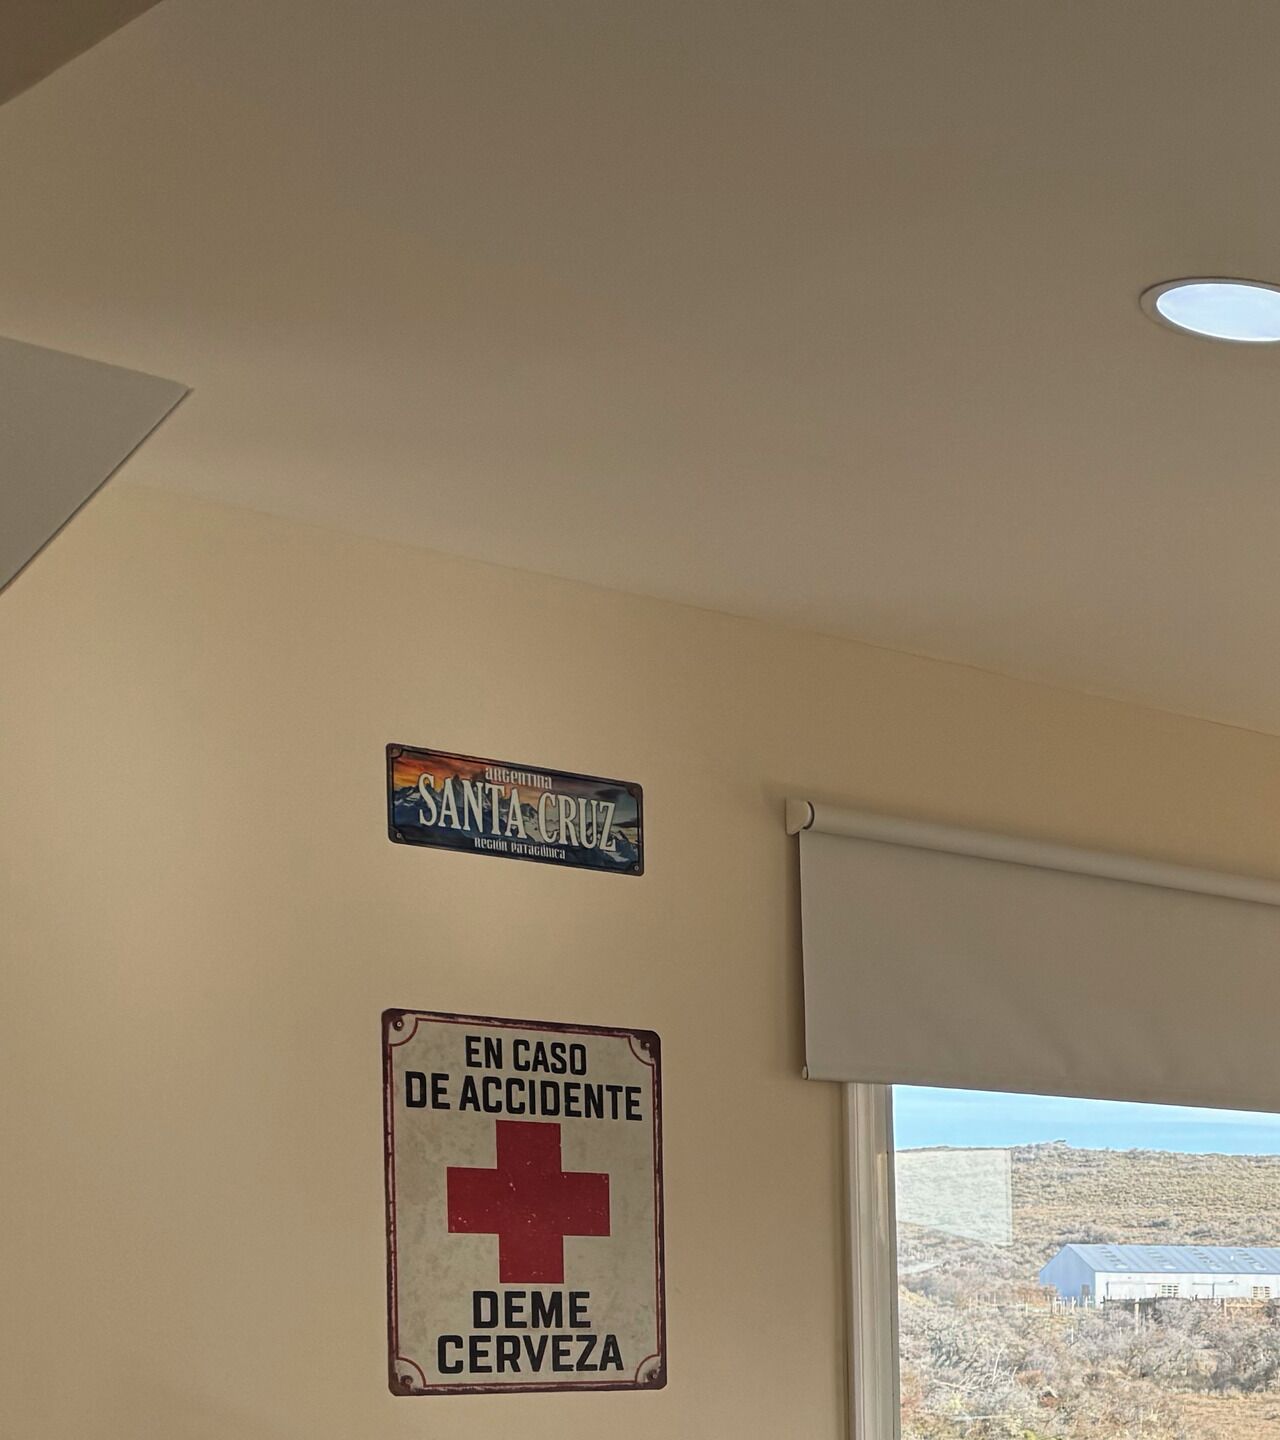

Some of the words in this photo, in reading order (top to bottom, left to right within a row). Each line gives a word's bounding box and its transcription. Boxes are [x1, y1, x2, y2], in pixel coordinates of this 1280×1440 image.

[418, 773, 527, 839] SANTA
[538, 792, 616, 852] CRUZ
[465, 1035, 503, 1069] EN
[513, 1039, 587, 1076] CASO
[405, 1071, 451, 1110] DE
[459, 1075, 643, 1121] ACCIDENTE
[472, 1290, 592, 1329] DEME
[437, 1334, 624, 1374] CERVEZA
